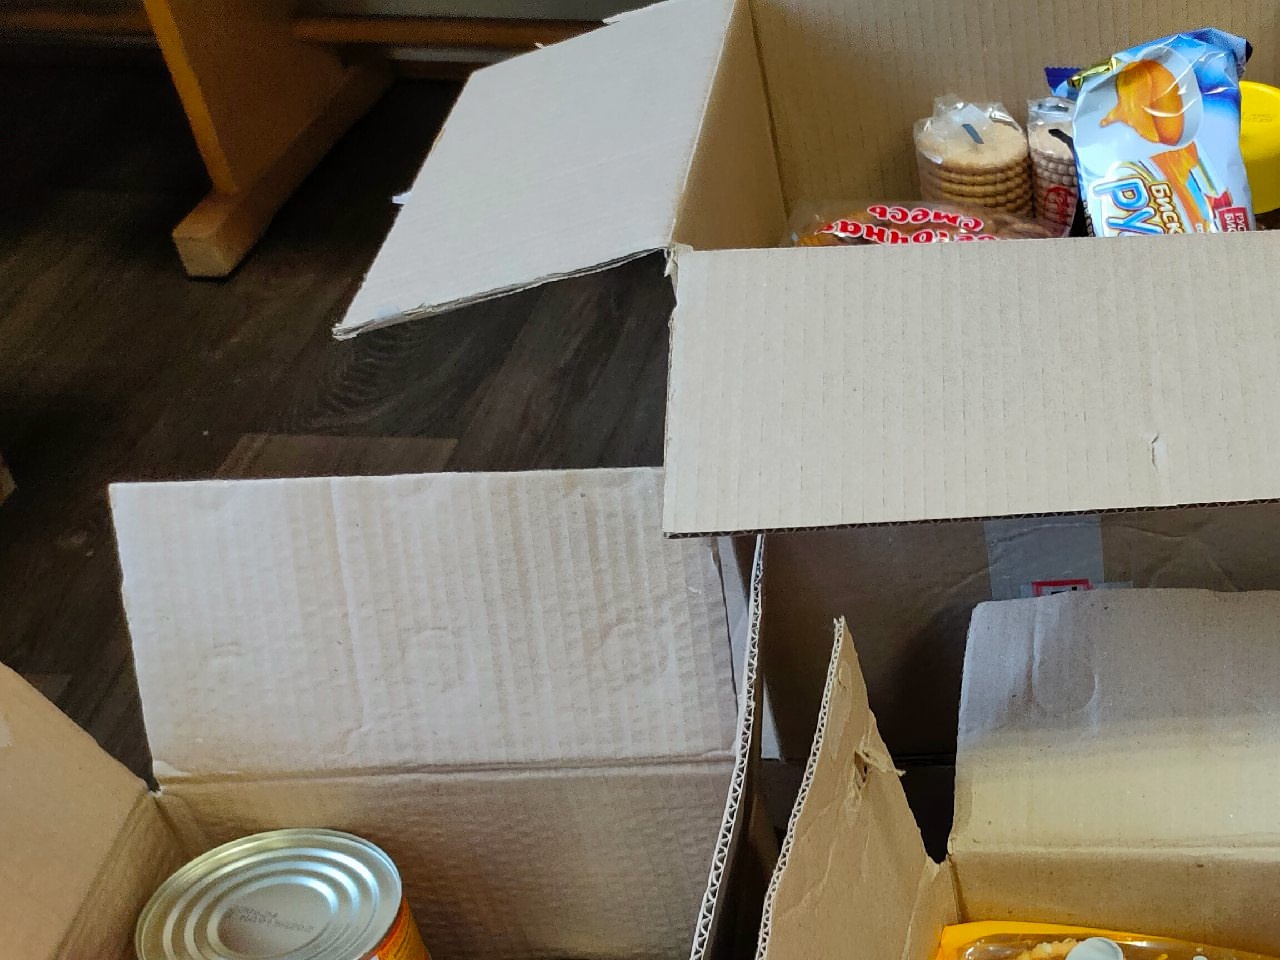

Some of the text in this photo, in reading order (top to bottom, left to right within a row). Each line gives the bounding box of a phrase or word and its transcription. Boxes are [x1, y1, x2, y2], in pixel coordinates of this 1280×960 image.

[867, 205, 984, 232] смесь
[1151, 182, 1186, 234] БИСК
[1237, 211, 1248, 232] РУС
